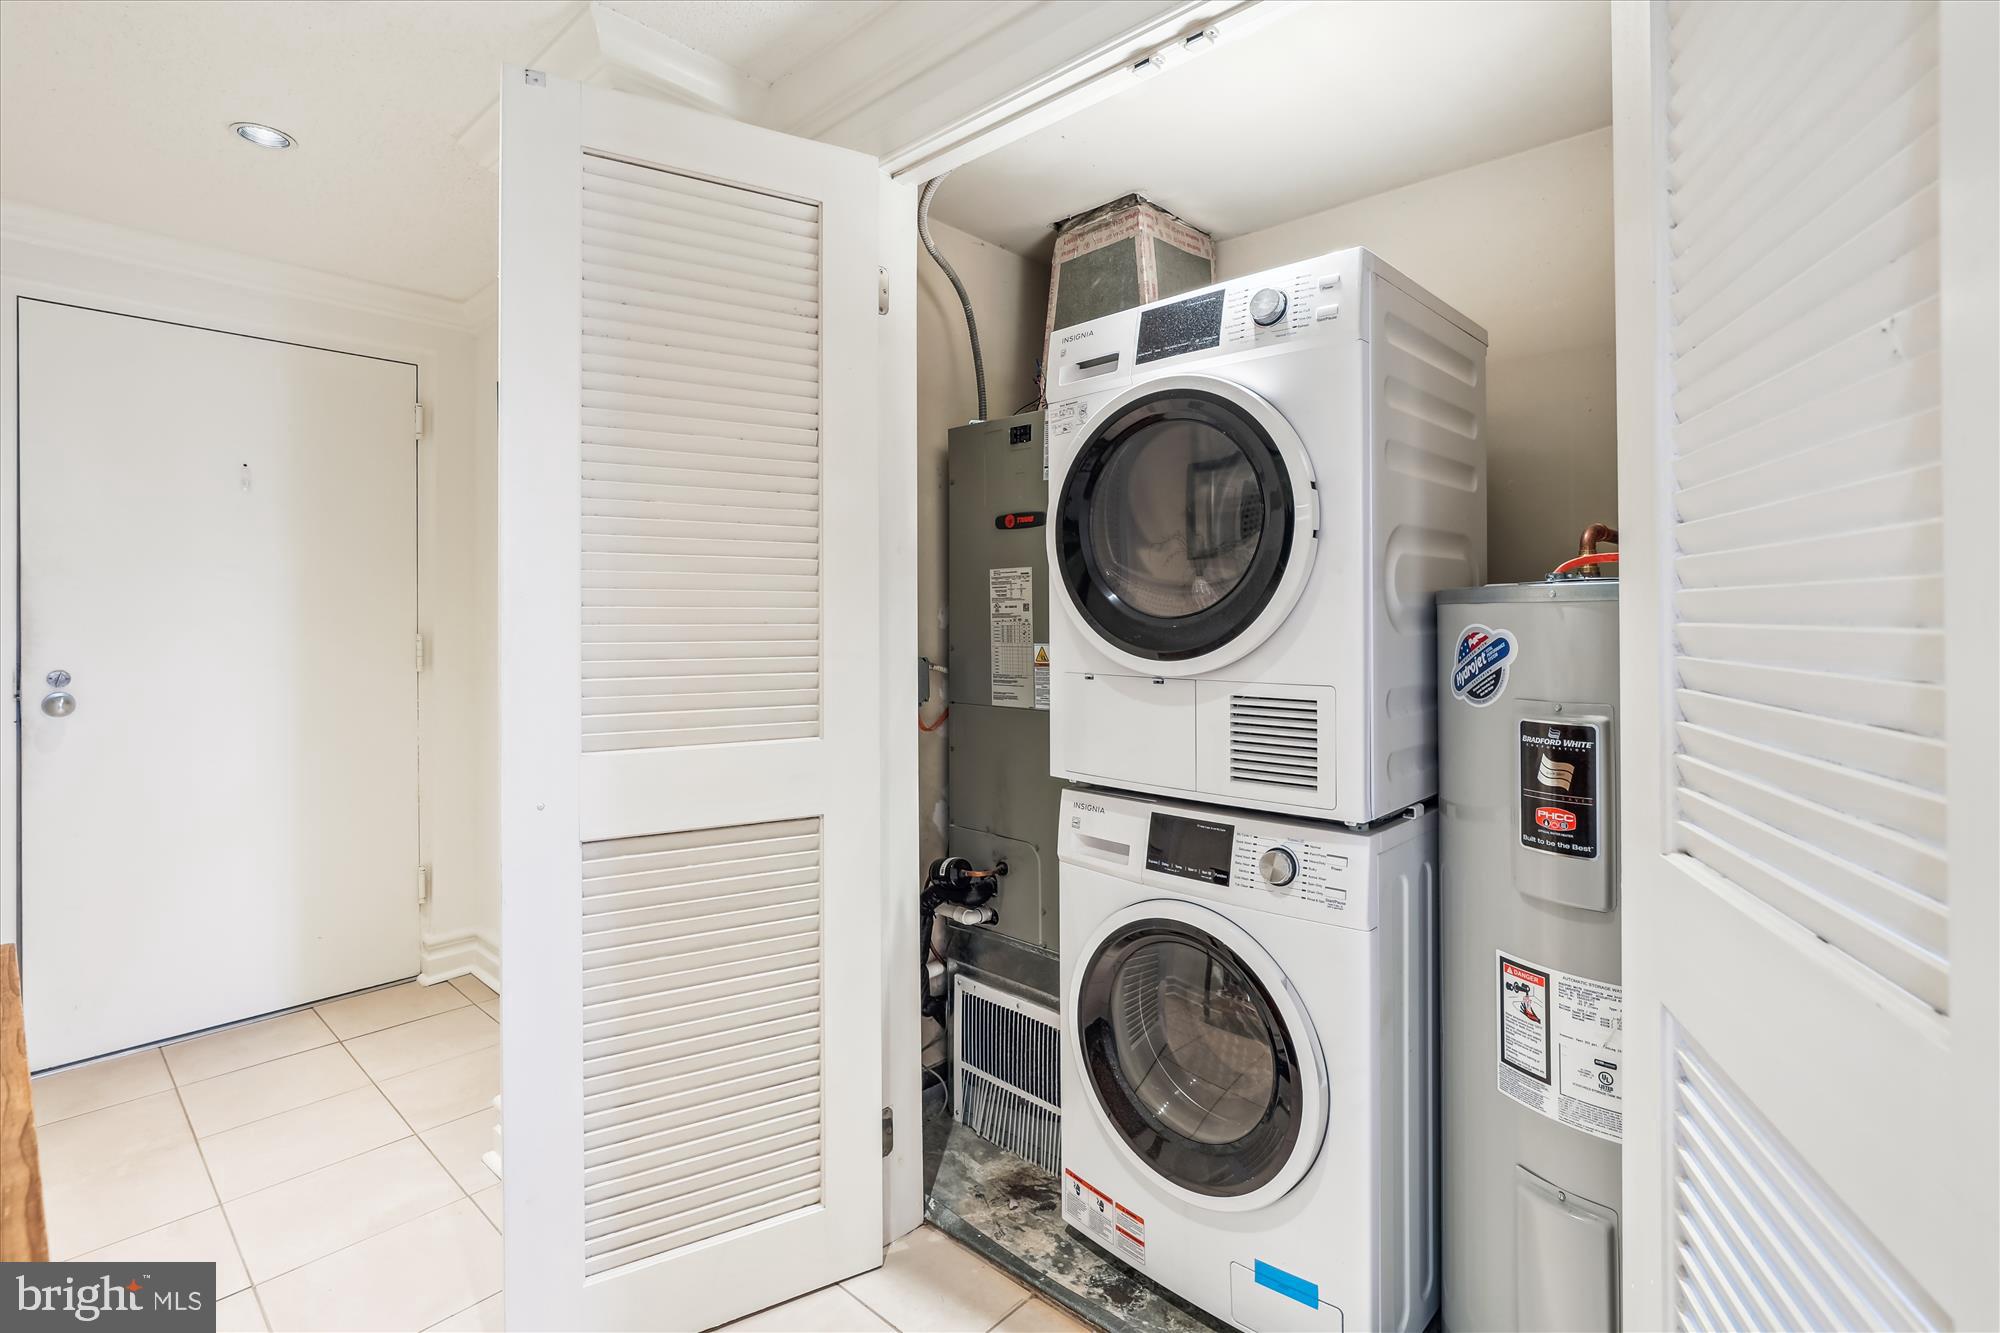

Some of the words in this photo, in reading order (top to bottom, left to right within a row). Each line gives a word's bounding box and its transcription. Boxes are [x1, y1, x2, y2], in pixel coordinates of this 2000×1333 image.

[1061, 330, 1094, 344] INSIGNIA
[1456, 652, 1487, 686] Hydrojet
[1522, 735, 1561, 746] BRADFORD
[1563, 740, 1593, 749] WHITE
[1073, 802, 1105, 813] INSIGNIA
[1537, 810, 1574, 822] PHCC
[1523, 834, 1536, 843] Built
[1546, 838, 1557, 847] be
[1557, 840, 1570, 850] the
[1572, 844, 1592, 852] Best
[1513, 968, 1539, 983] DANGER
[1562, 976, 1588, 987] AUTOMATIC
[1588, 982, 1611, 993] STORAGE
[1600, 1073, 1611, 1084] UL
